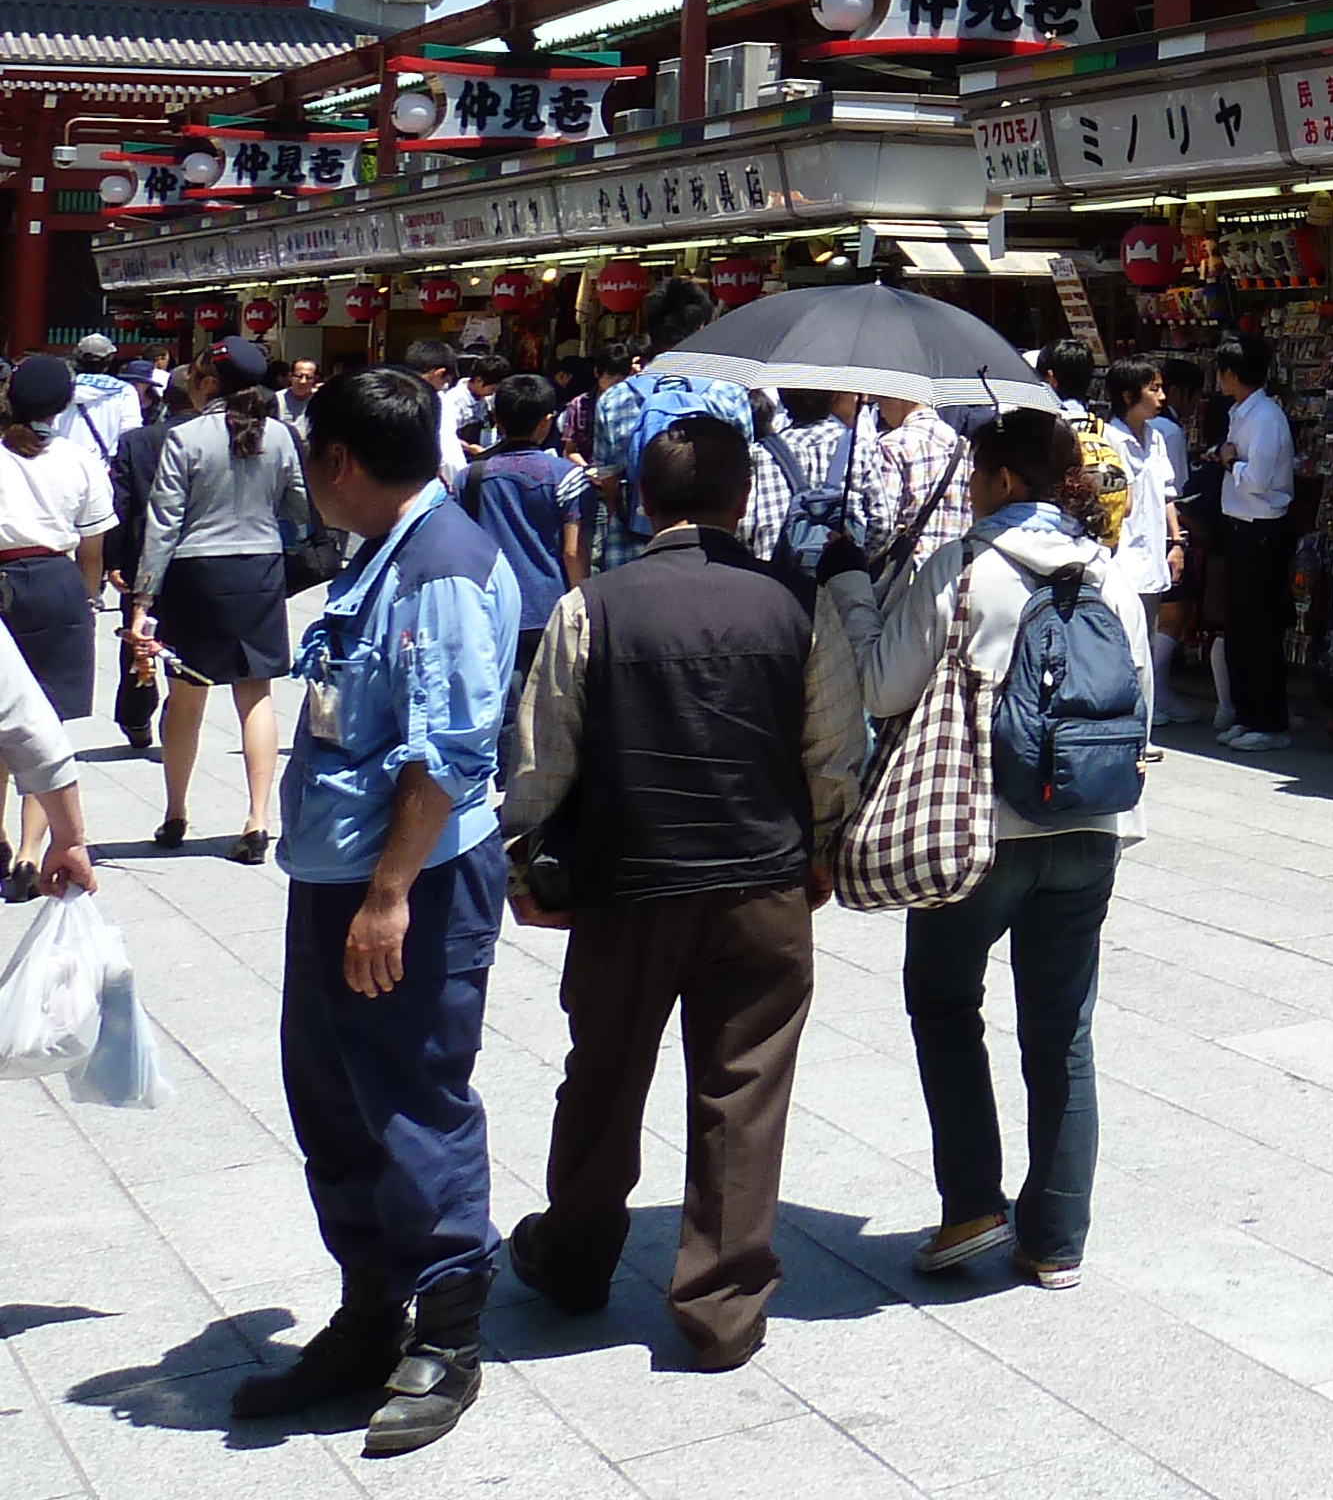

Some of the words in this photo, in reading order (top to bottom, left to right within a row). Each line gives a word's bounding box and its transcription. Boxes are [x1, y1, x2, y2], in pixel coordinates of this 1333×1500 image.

[455, 80, 592, 134] 仲見世
[977, 117, 1037, 149] フクロモノ
[1080, 96, 1241, 167] ミノリヤ
[232, 143, 345, 183] 仲見世
